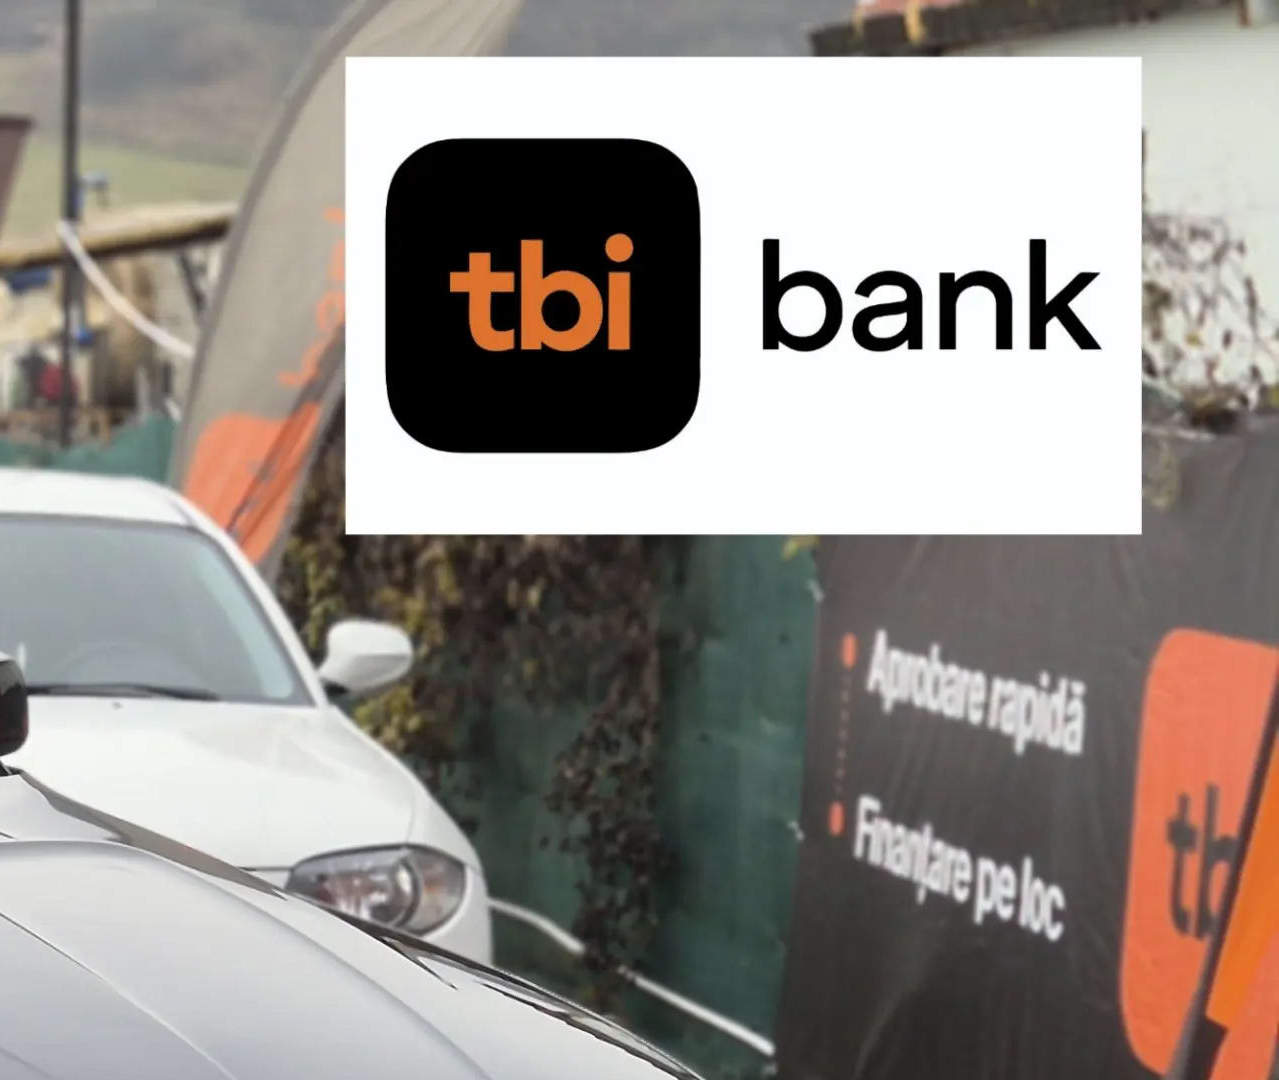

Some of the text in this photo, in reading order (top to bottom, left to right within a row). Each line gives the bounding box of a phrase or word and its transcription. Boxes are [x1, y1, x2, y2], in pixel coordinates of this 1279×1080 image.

[866, 628, 1087, 756] Aprobare rapidă
[974, 855, 1018, 926] pe
[1018, 855, 1066, 942] loc
[1166, 783, 1238, 940] tb
